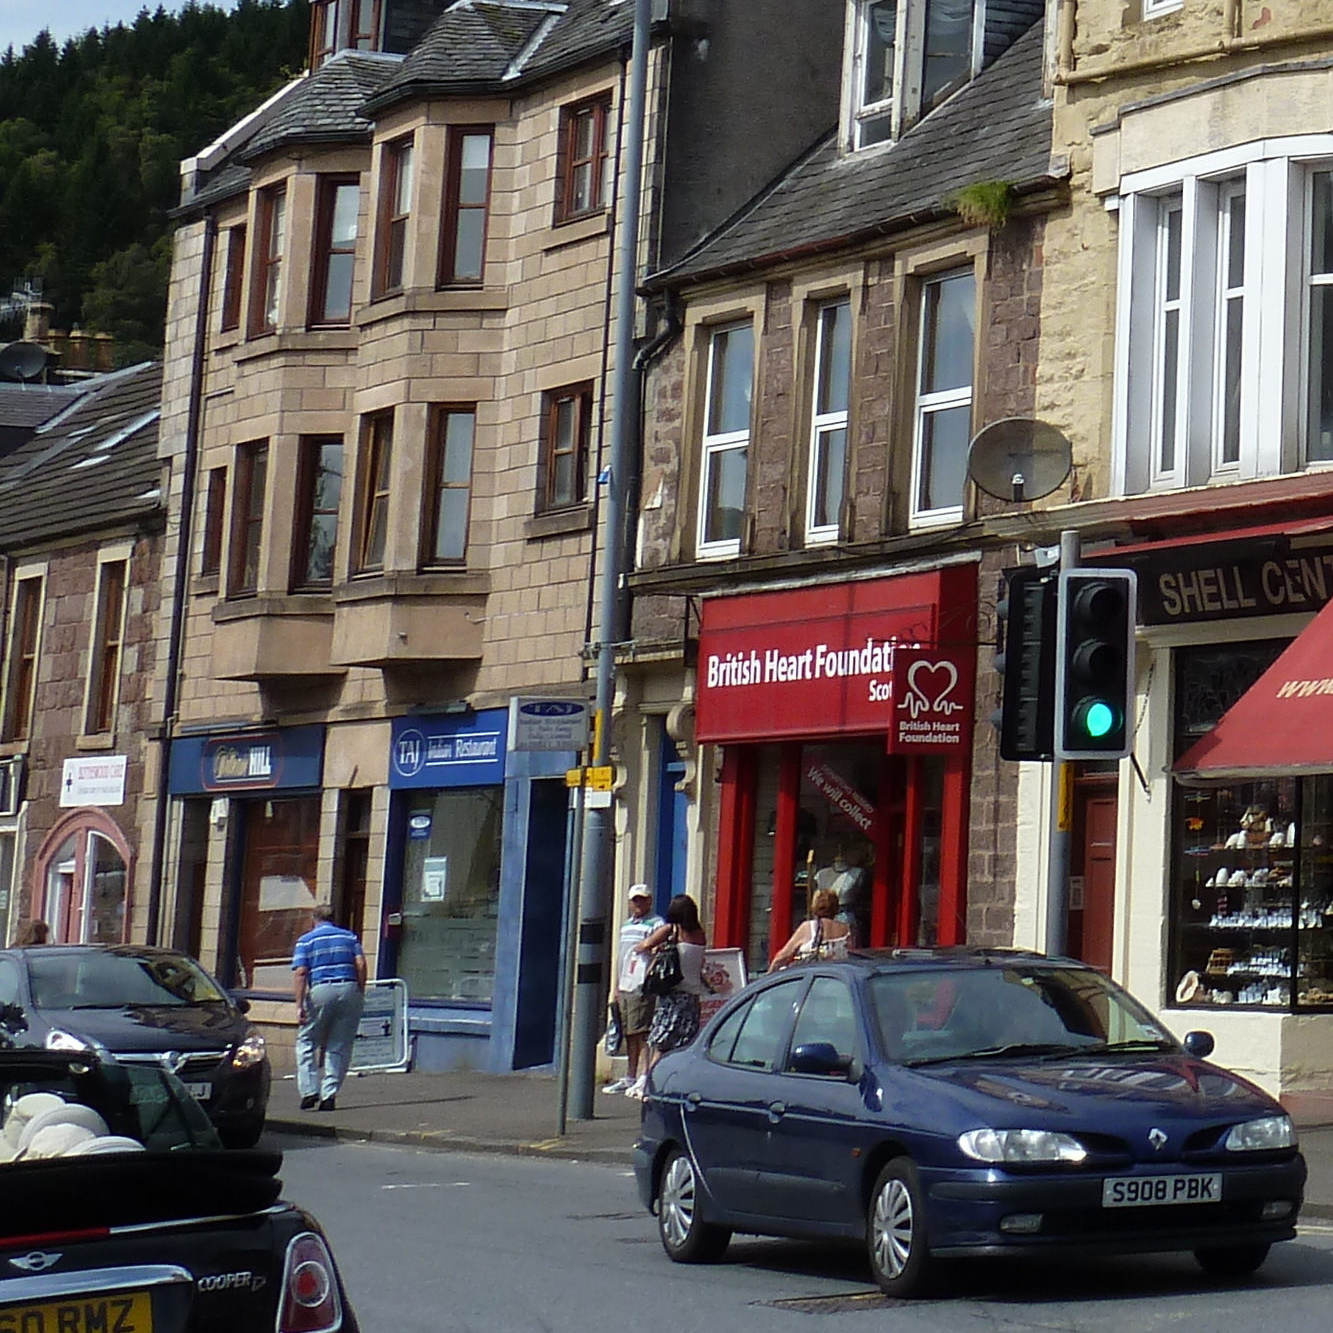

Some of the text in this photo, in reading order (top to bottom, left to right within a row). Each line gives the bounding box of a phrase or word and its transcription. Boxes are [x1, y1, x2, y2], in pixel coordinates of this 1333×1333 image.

[1159, 566, 1256, 616] SHELL
[708, 636, 920, 688] British Heart Foundati
[899, 732, 960, 743] Foundation
[900, 721, 960, 731] British Heart
[249, 746, 271, 775] HILL
[400, 740, 420, 770] TAJ
[455, 738, 497, 758] Restaurant
[807, 766, 872, 830] We will collect
[1112, 1177, 1213, 1203] S908 PBK
[198, 1271, 252, 1292] COOPER
[57, 1298, 135, 1333] RMZ
